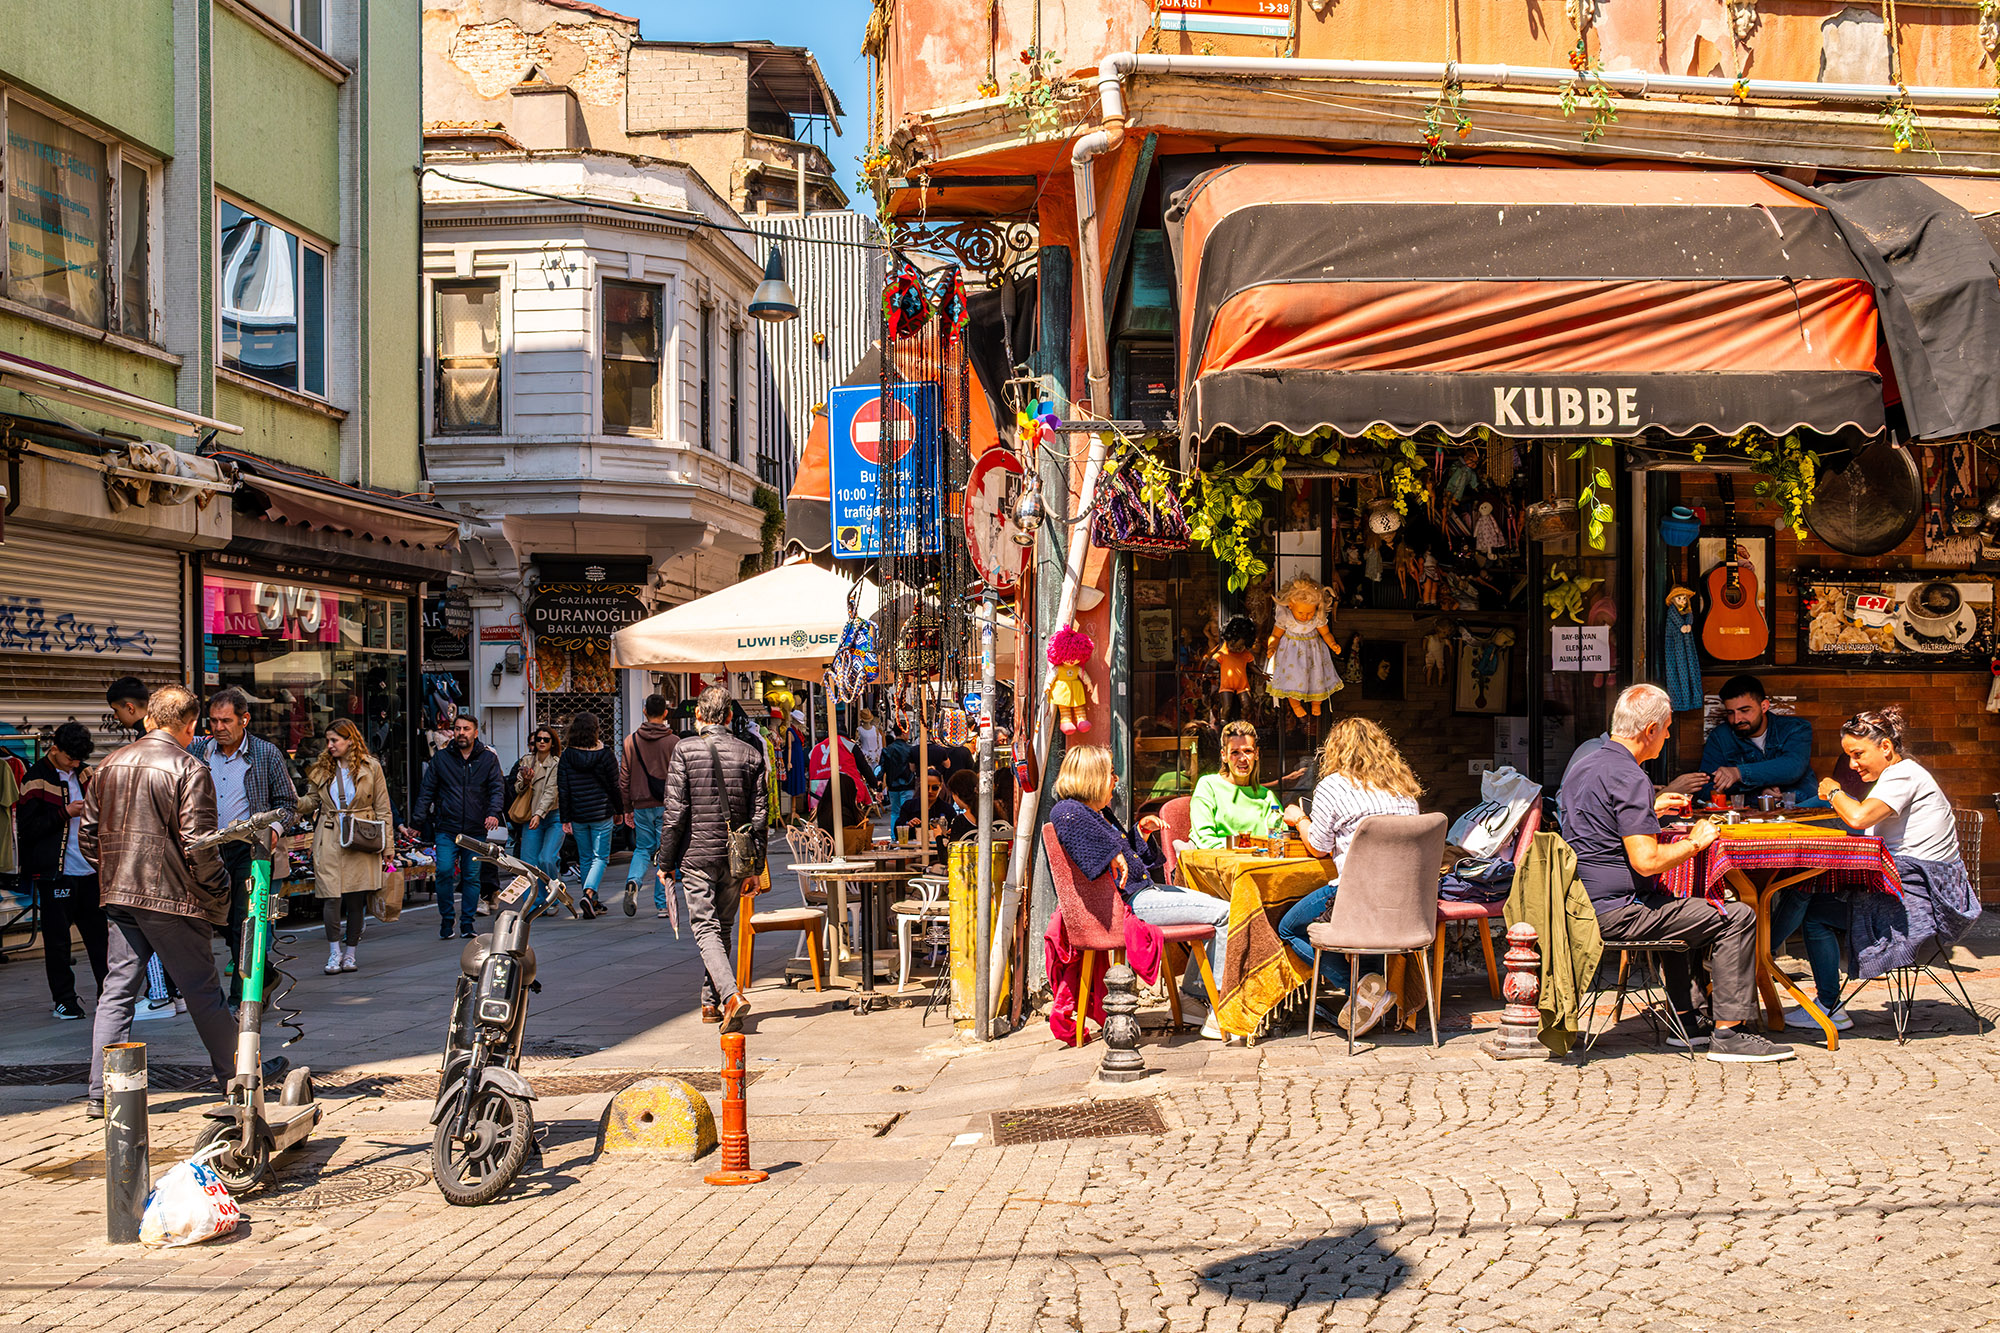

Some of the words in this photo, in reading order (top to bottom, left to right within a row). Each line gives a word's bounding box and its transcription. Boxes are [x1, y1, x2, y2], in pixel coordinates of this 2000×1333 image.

[33, 141, 65, 168] TRAVEL
[67, 155, 97, 182] AGENCY
[75, 232, 95, 248] tours
[1493, 387, 1640, 426] KUBBE
[860, 470, 875, 482] Bu
[837, 488, 867, 501] 10:00
[536, 607, 642, 622] DURANOĞLU
[738, 637, 776, 648] LUWI
[53, 888, 71, 896] EA7
